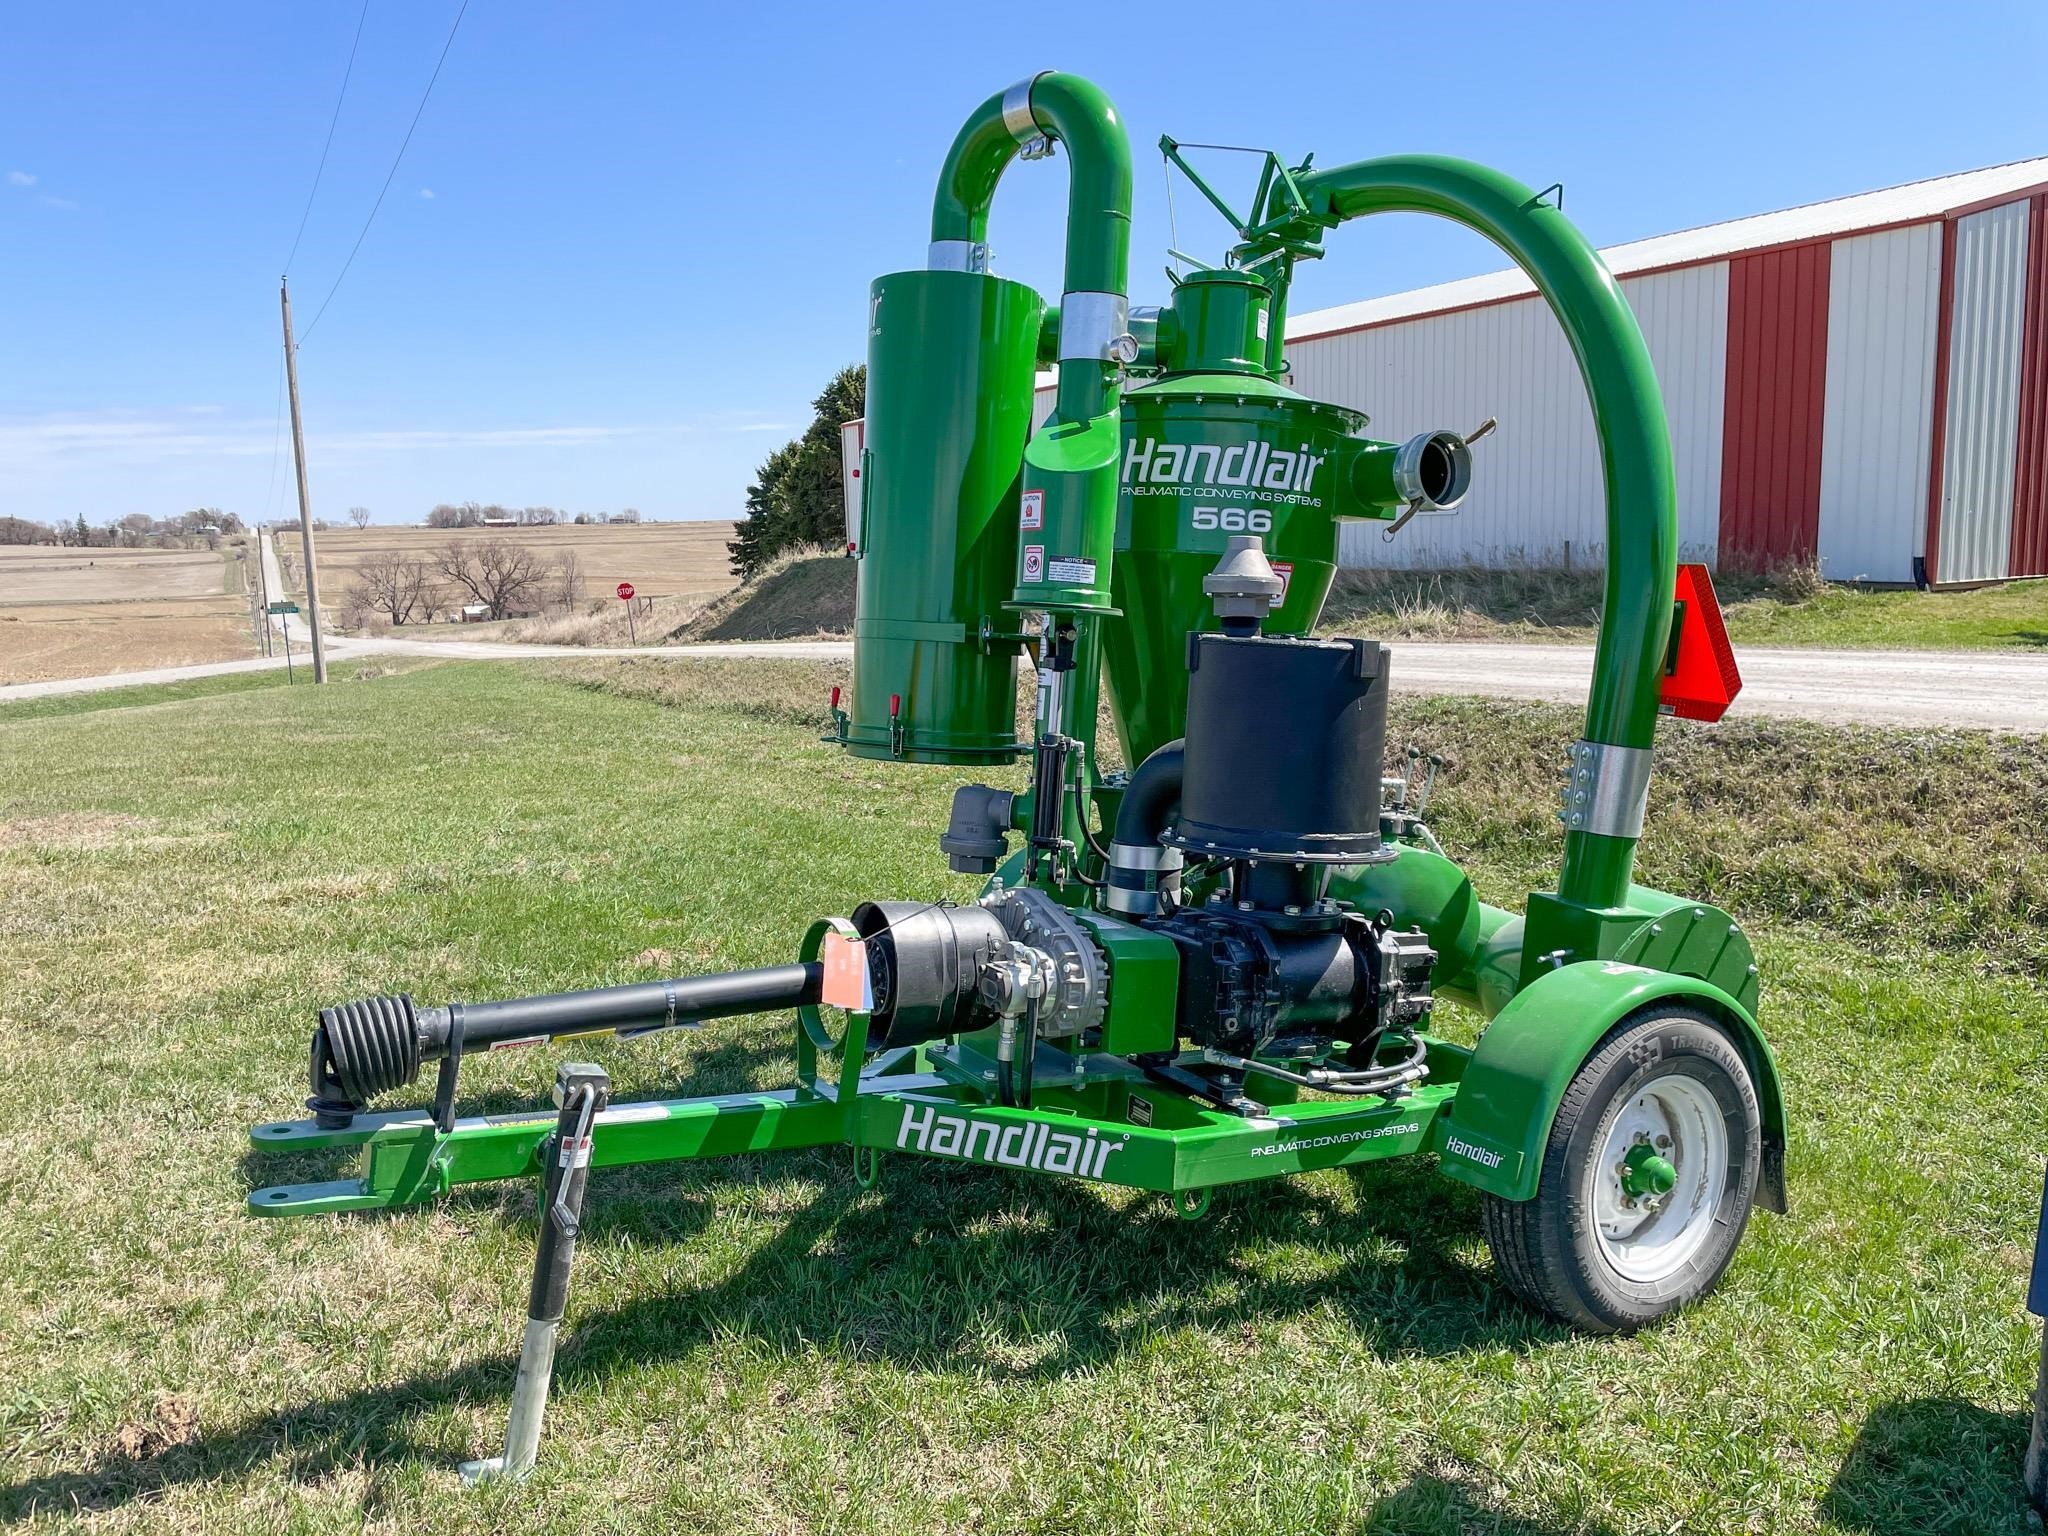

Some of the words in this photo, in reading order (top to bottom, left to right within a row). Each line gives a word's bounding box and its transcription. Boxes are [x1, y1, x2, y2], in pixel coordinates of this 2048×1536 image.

[1121, 438, 1324, 493] Handlair
[1121, 486, 1191, 497] PNEUMATIC
[1193, 487, 1272, 502] CONVEYING
[1274, 493, 1322, 508] SYSTEMS
[1191, 506, 1273, 533] 566
[618, 587, 633, 596] STOP
[1671, 1035, 1720, 1057] TRAILER
[1720, 1050, 1744, 1082] KING
[896, 1103, 1124, 1179] Handlair
[1251, 1139, 1312, 1158] PNEUMATIC
[1313, 1129, 1372, 1148] CONVEYING
[1373, 1122, 1419, 1139] SYSTEMS
[1446, 1135, 1504, 1169] Handlair
